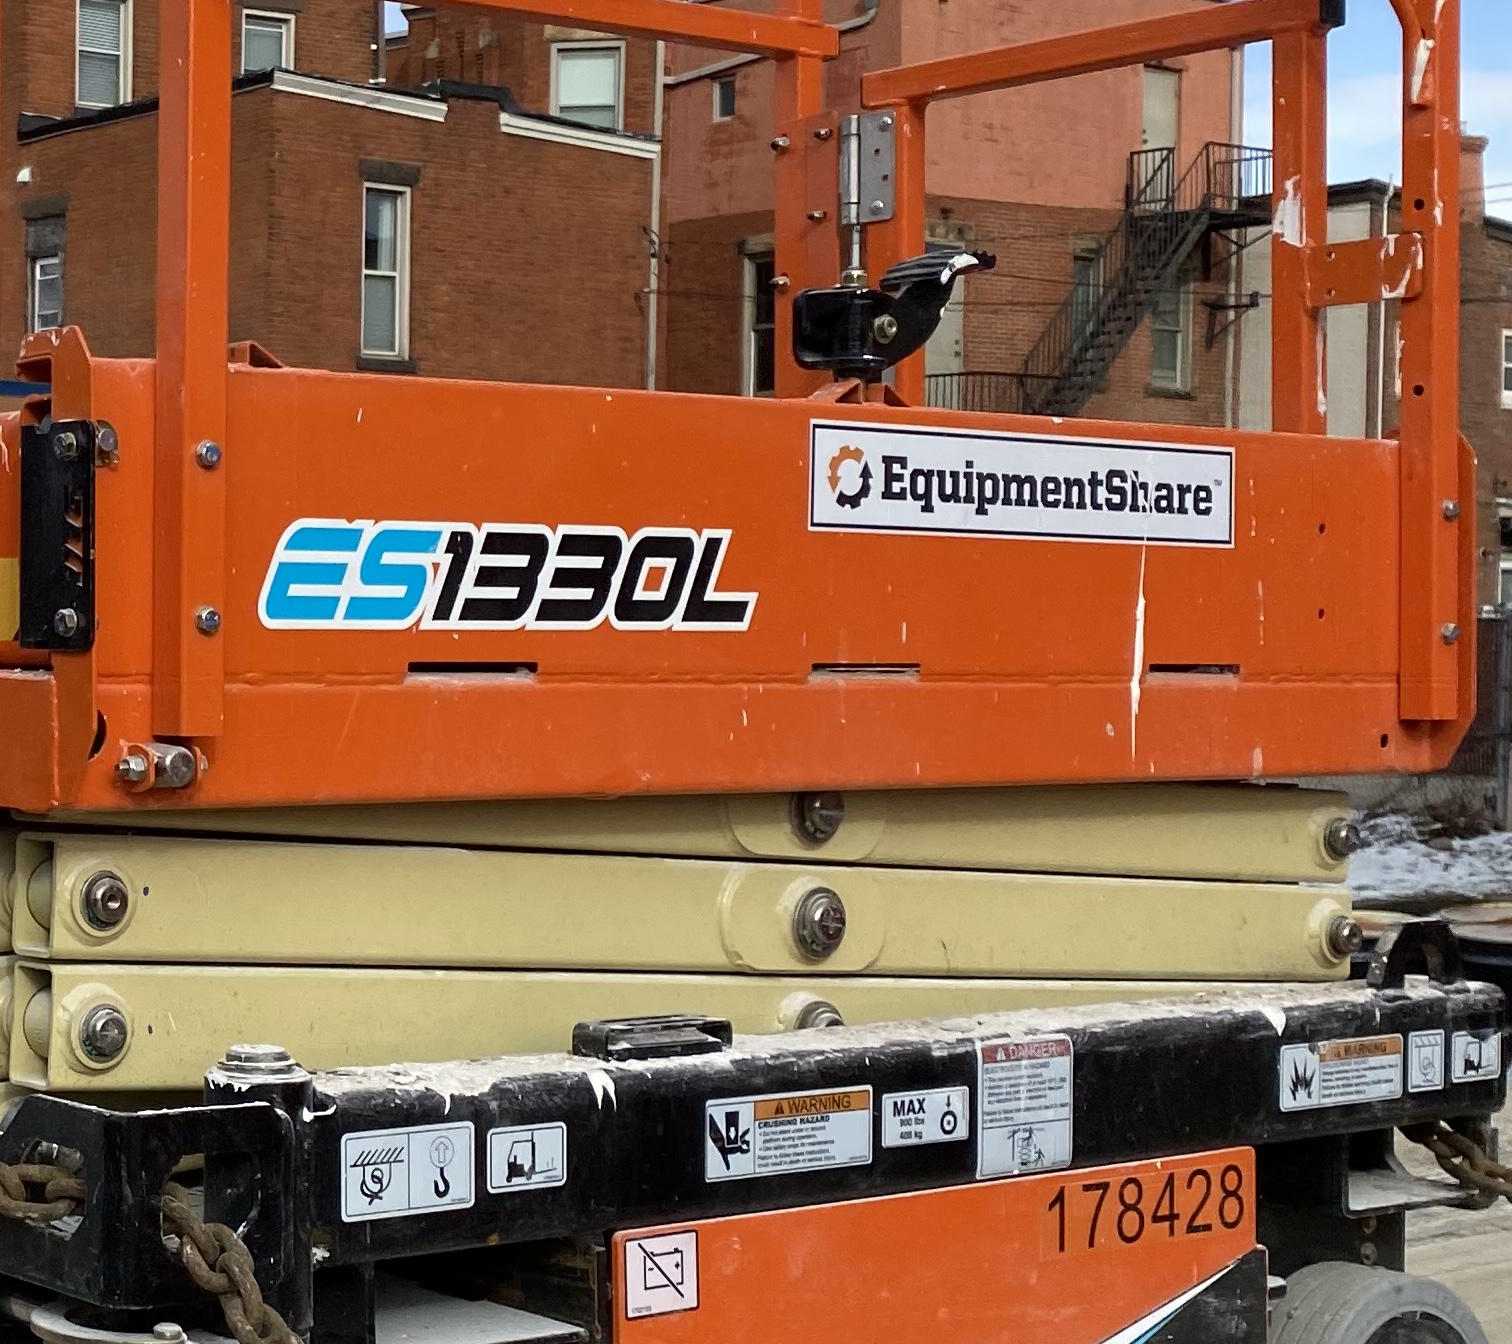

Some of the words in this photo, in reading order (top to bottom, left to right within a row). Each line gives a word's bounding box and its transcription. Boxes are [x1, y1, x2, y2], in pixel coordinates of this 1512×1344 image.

[881, 454, 1214, 516] EquipmentShare
[263, 525, 752, 624] ES1330L
[1009, 1042, 1058, 1059] DANGER
[786, 1094, 852, 1115] WARNING
[892, 1097, 926, 1118] MAX
[1047, 1164, 1246, 1254] 178428
